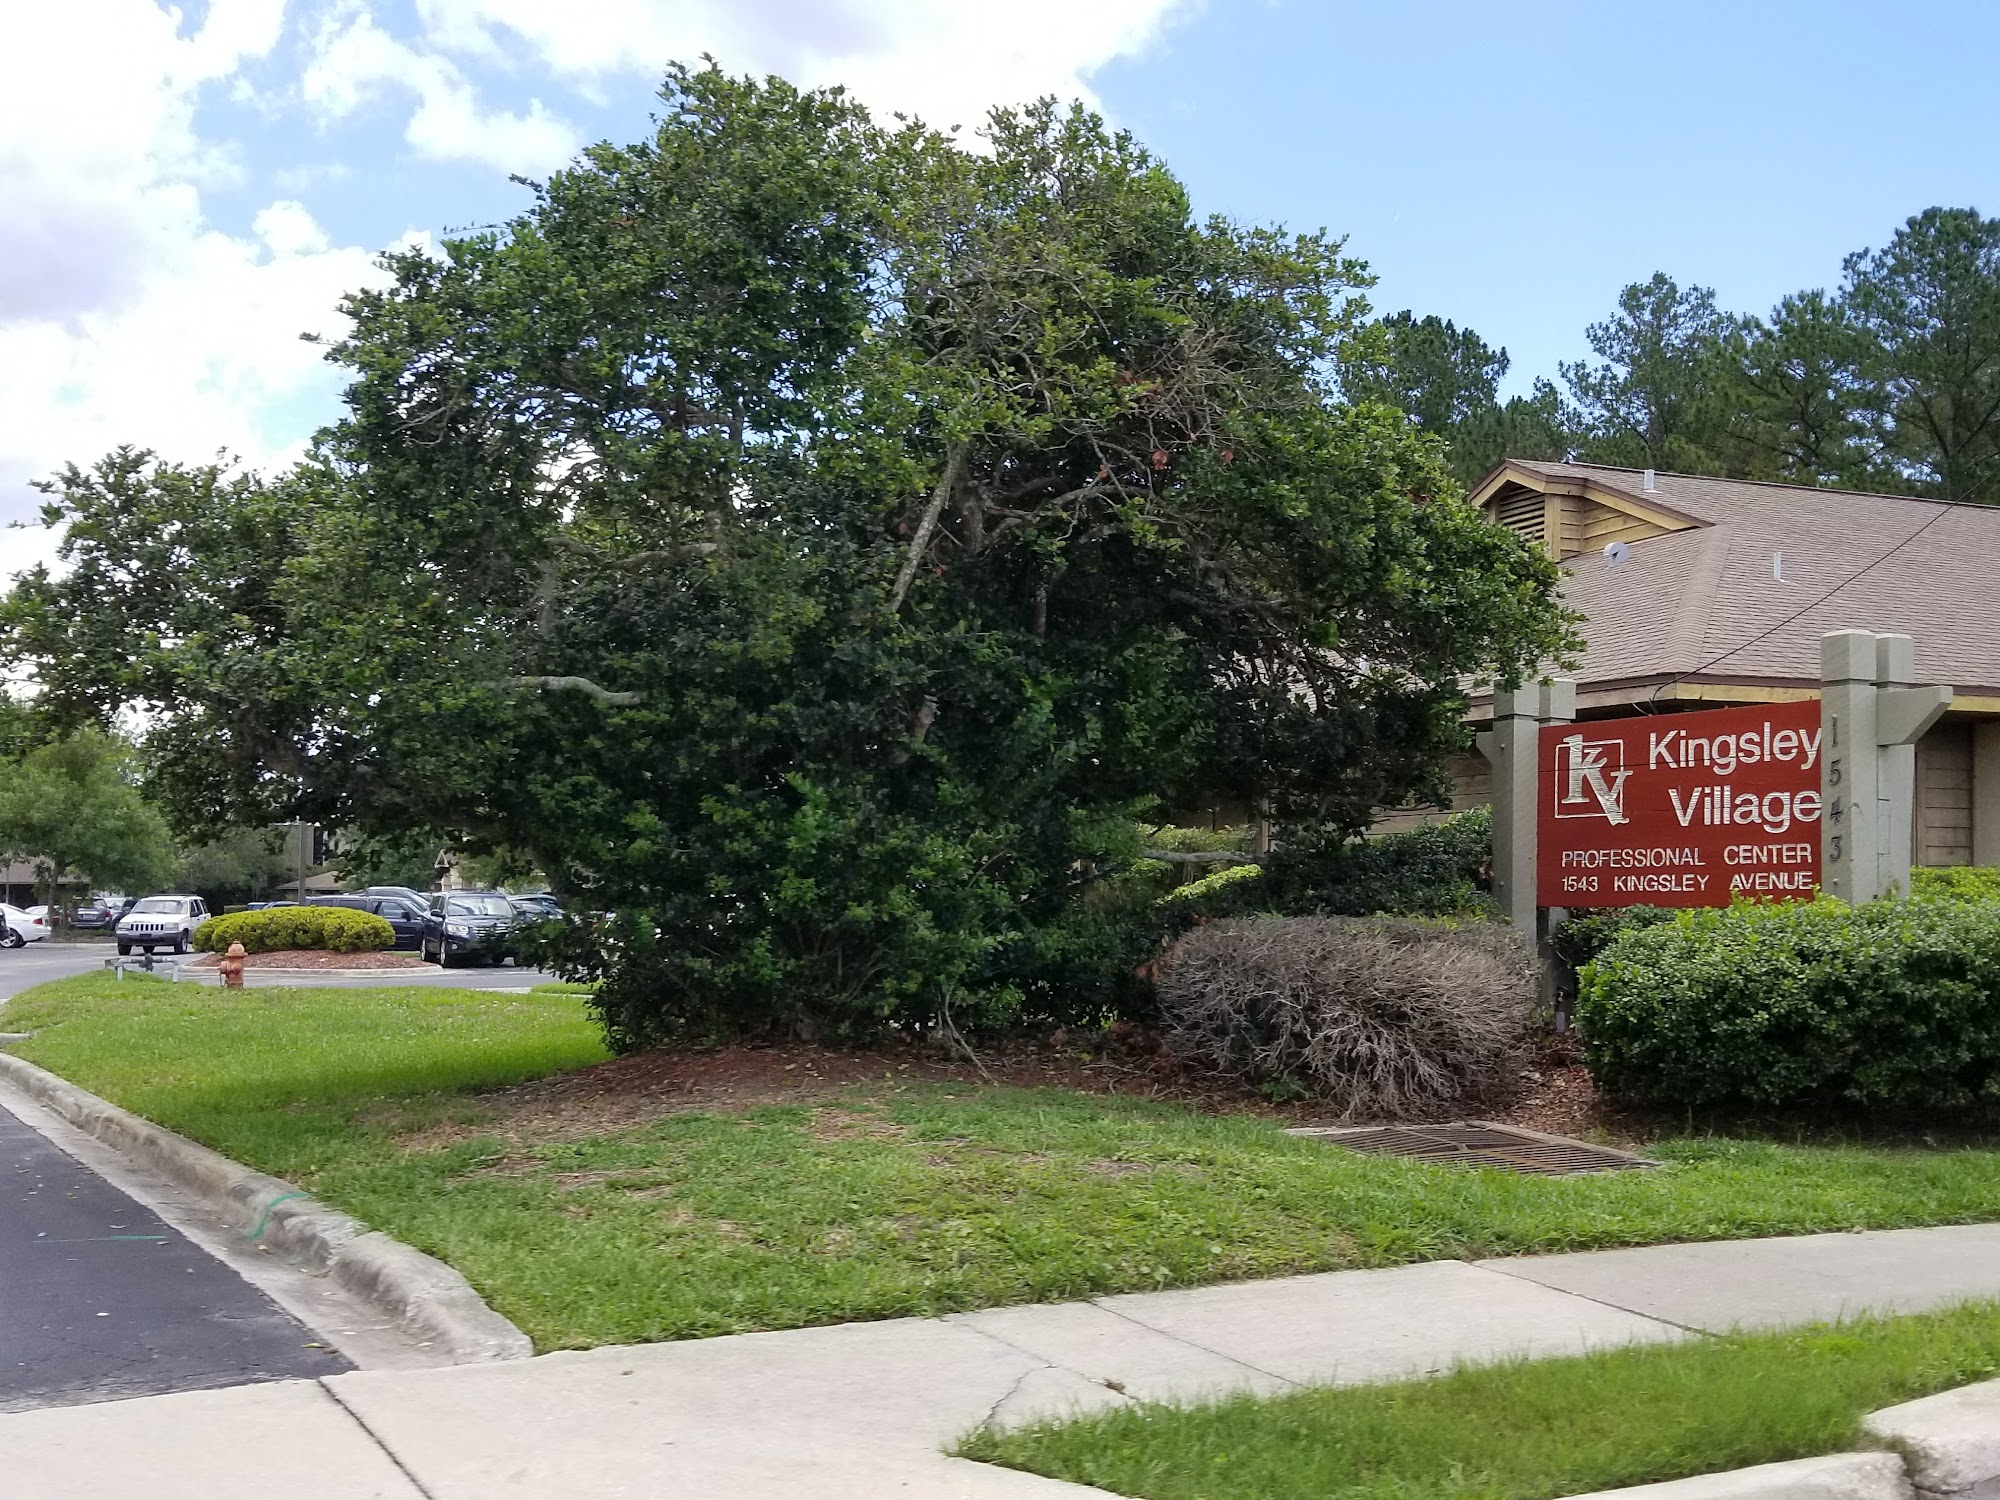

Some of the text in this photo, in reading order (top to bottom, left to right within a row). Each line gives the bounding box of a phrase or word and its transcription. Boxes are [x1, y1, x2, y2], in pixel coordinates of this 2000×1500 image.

[1649, 722, 1821, 775] Kingsley
[1668, 785, 1822, 833] Village
[1828, 715, 1843, 862] 1543
[1561, 843, 1813, 868] PROFESSIONAL CENTER
[1561, 871, 1813, 893] 1543 KINGSLEY AVENUE
